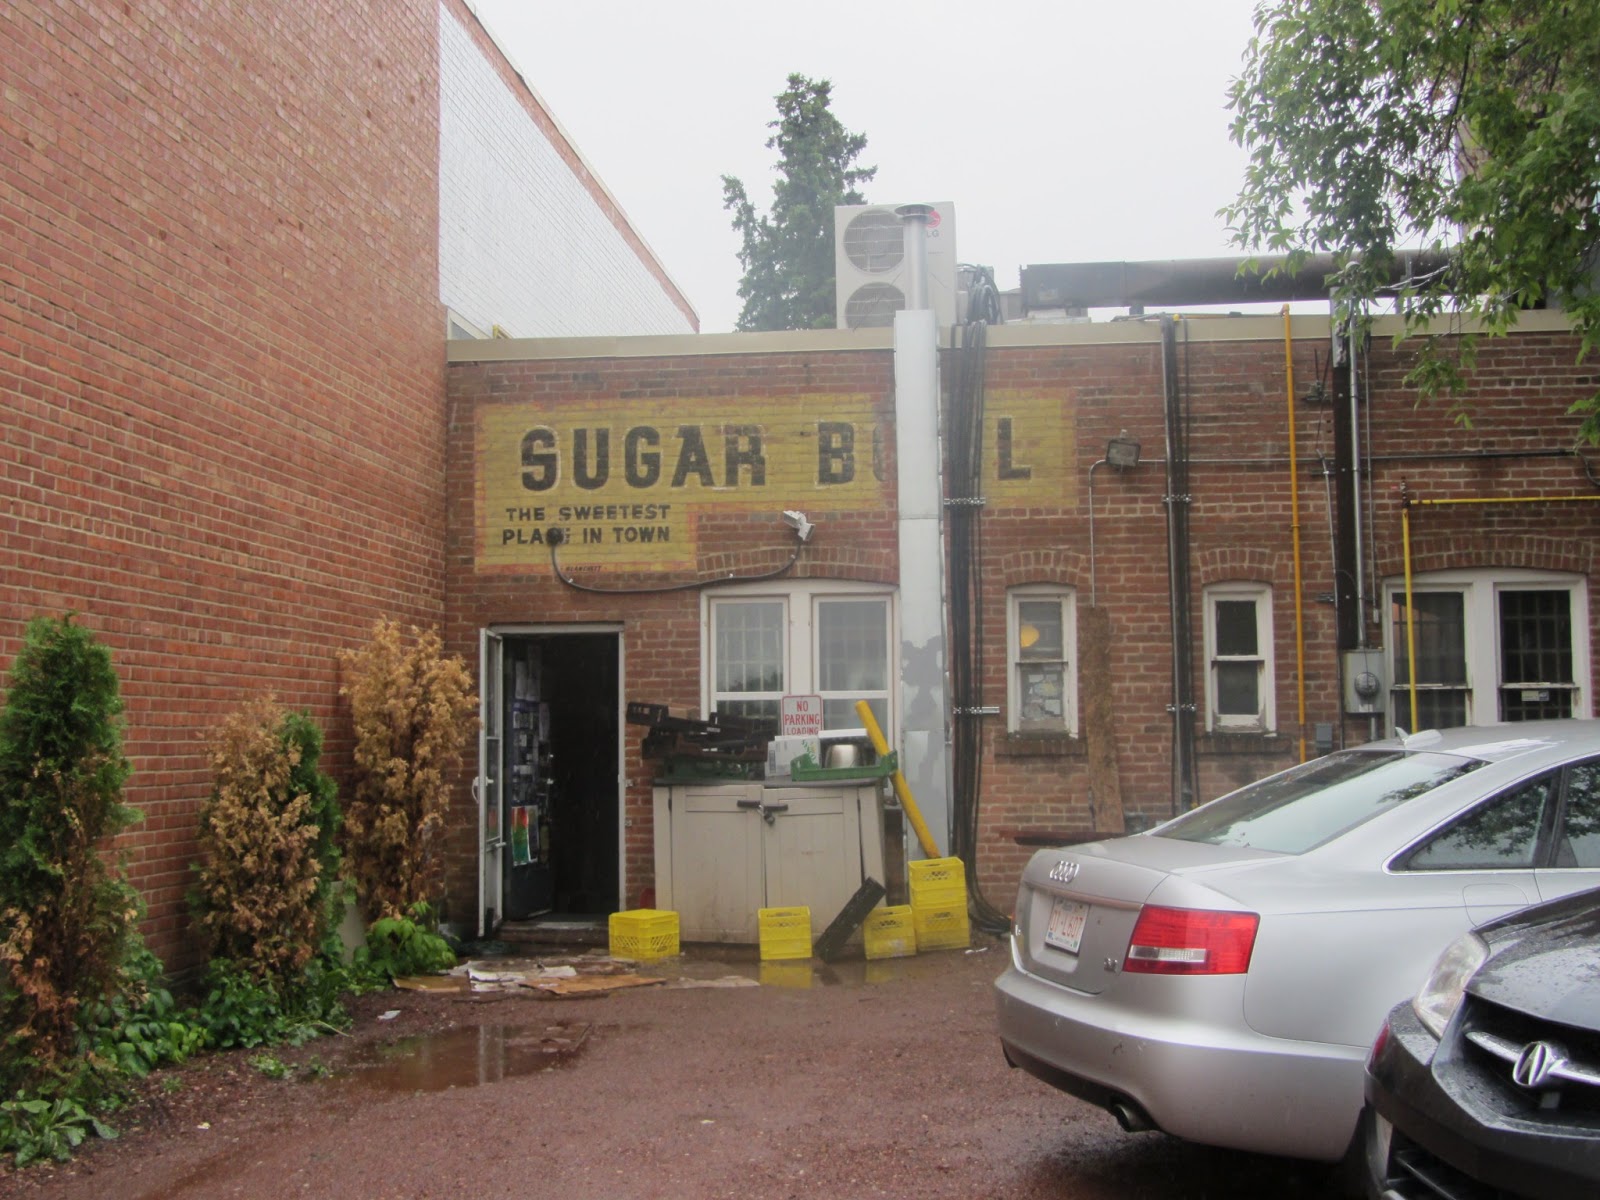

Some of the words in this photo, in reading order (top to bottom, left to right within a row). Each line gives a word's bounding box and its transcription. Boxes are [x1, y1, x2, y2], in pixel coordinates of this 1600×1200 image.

[520, 424, 766, 491] SUGAR
[817, 416, 1031, 484] BL
[506, 507, 546, 521] THE
[558, 504, 671, 520] SWEETEST
[502, 527, 571, 545] PLAE
[583, 527, 603, 543] IN
[613, 526, 670, 542] TOWN
[796, 700, 809, 712] NO
[784, 713, 820, 725] PARKING
[786, 726, 819, 735] LOADING
